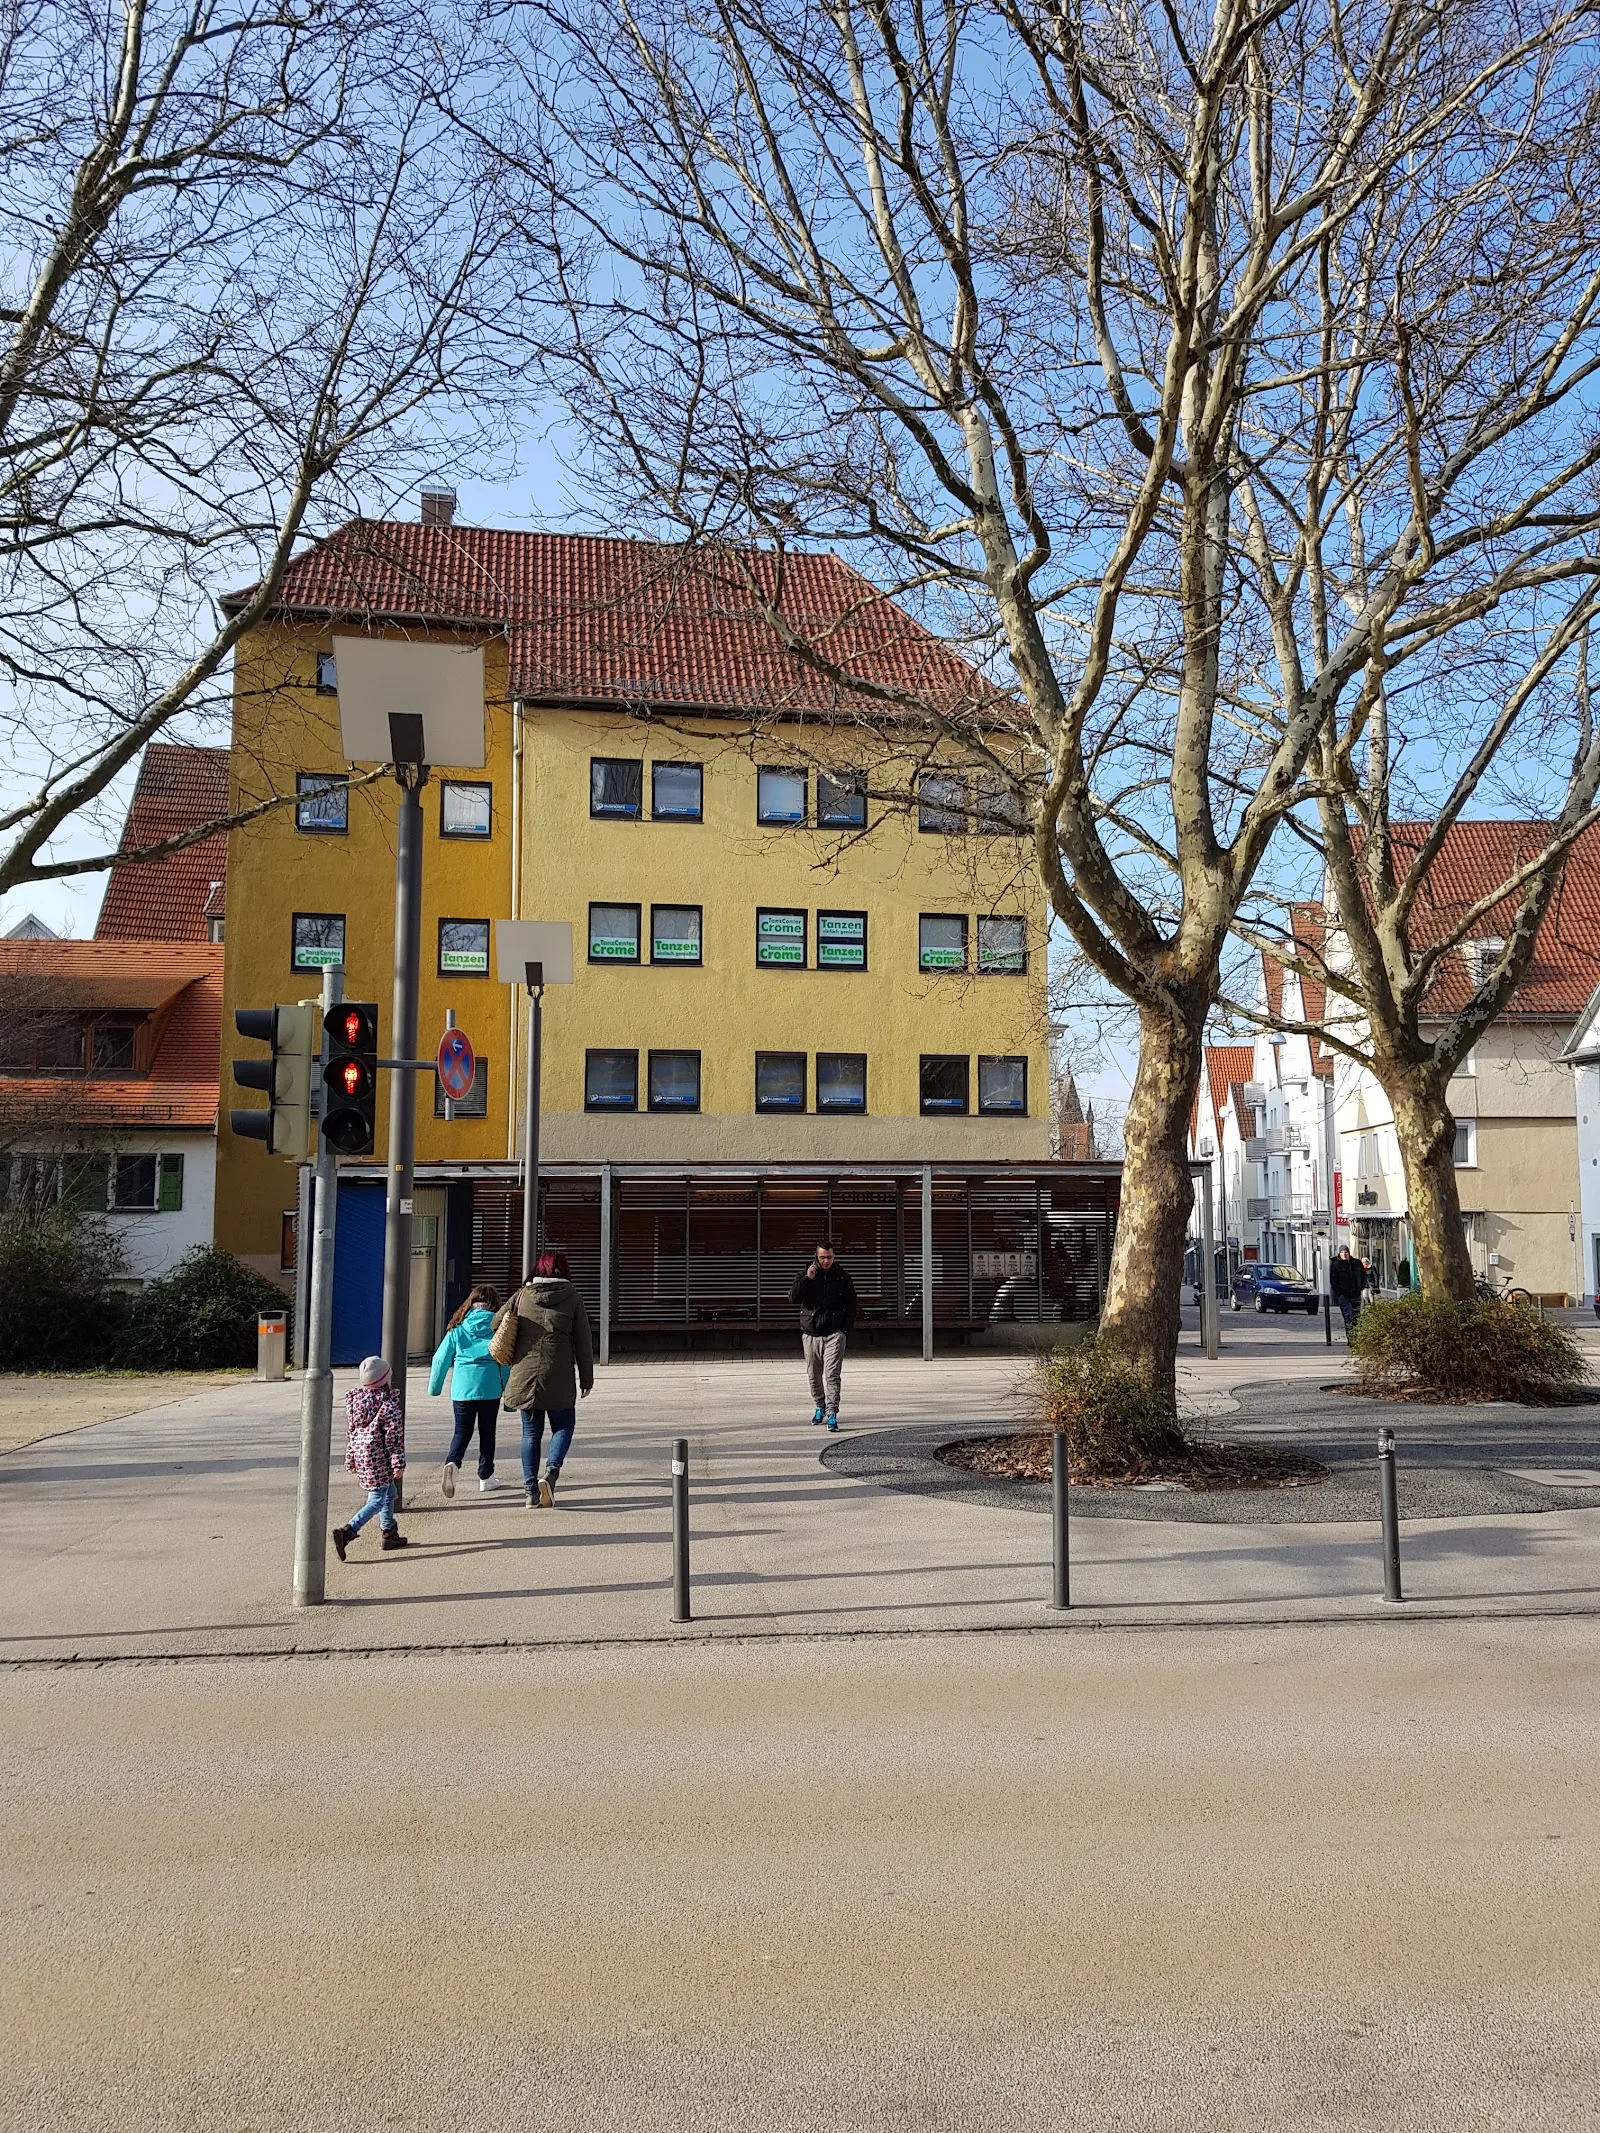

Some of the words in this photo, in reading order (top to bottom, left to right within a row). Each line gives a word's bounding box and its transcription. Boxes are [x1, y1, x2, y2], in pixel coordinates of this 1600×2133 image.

[761, 921, 802, 933] Crome
[821, 919, 862, 929] Tanzen
[592, 943, 636, 956] Crome
[655, 941, 698, 951] Tanzen
[821, 946, 862, 956] Tanzen
[297, 953, 341, 964] Crome
[443, 952, 485, 963] Tanzen
[760, 948, 801, 960] Crome
